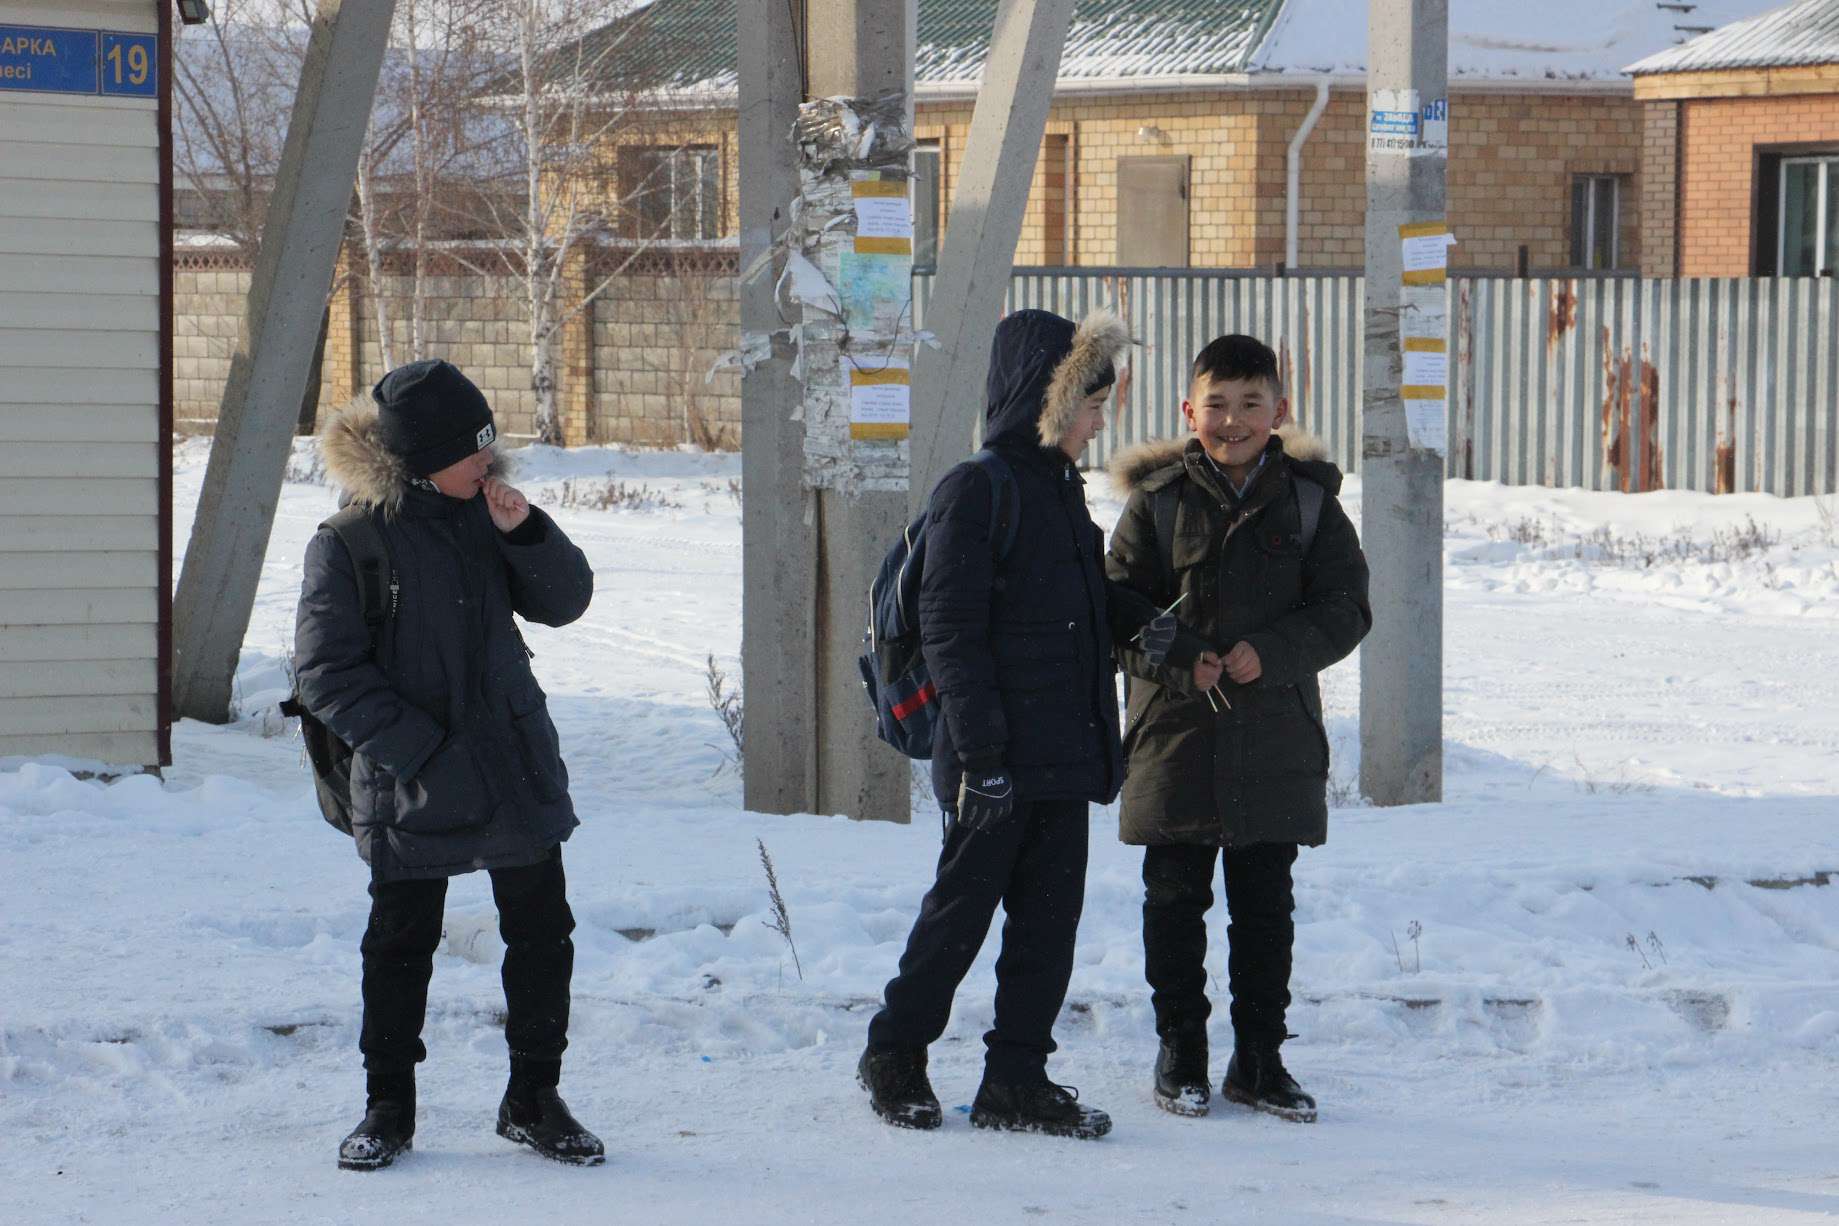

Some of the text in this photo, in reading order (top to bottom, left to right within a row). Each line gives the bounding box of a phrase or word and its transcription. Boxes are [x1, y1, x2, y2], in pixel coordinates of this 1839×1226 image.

[0, 37, 57, 57] АРКА
[107, 44, 149, 85] 19
[981, 776, 1005, 786] SPORT
